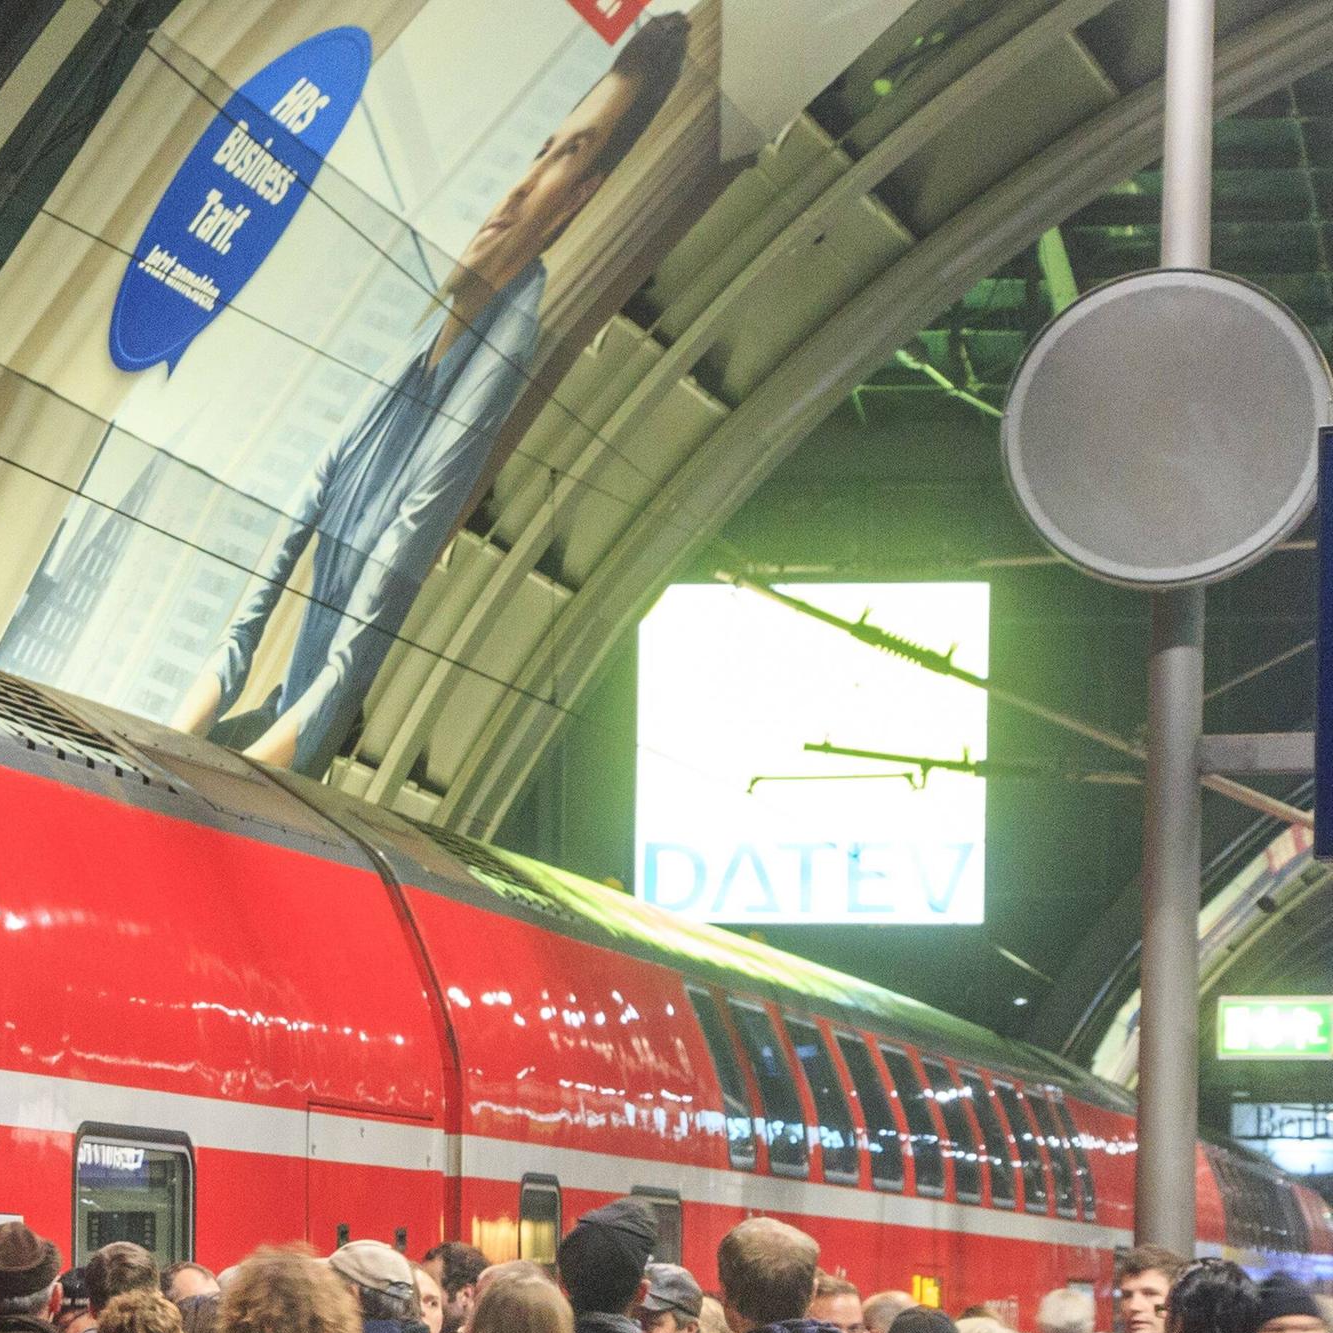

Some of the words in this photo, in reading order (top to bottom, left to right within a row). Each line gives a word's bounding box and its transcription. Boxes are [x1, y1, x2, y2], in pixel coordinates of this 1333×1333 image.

[270, 77, 331, 134] HRS
[212, 120, 299, 205] Business
[644, 842, 974, 913] DATEV
